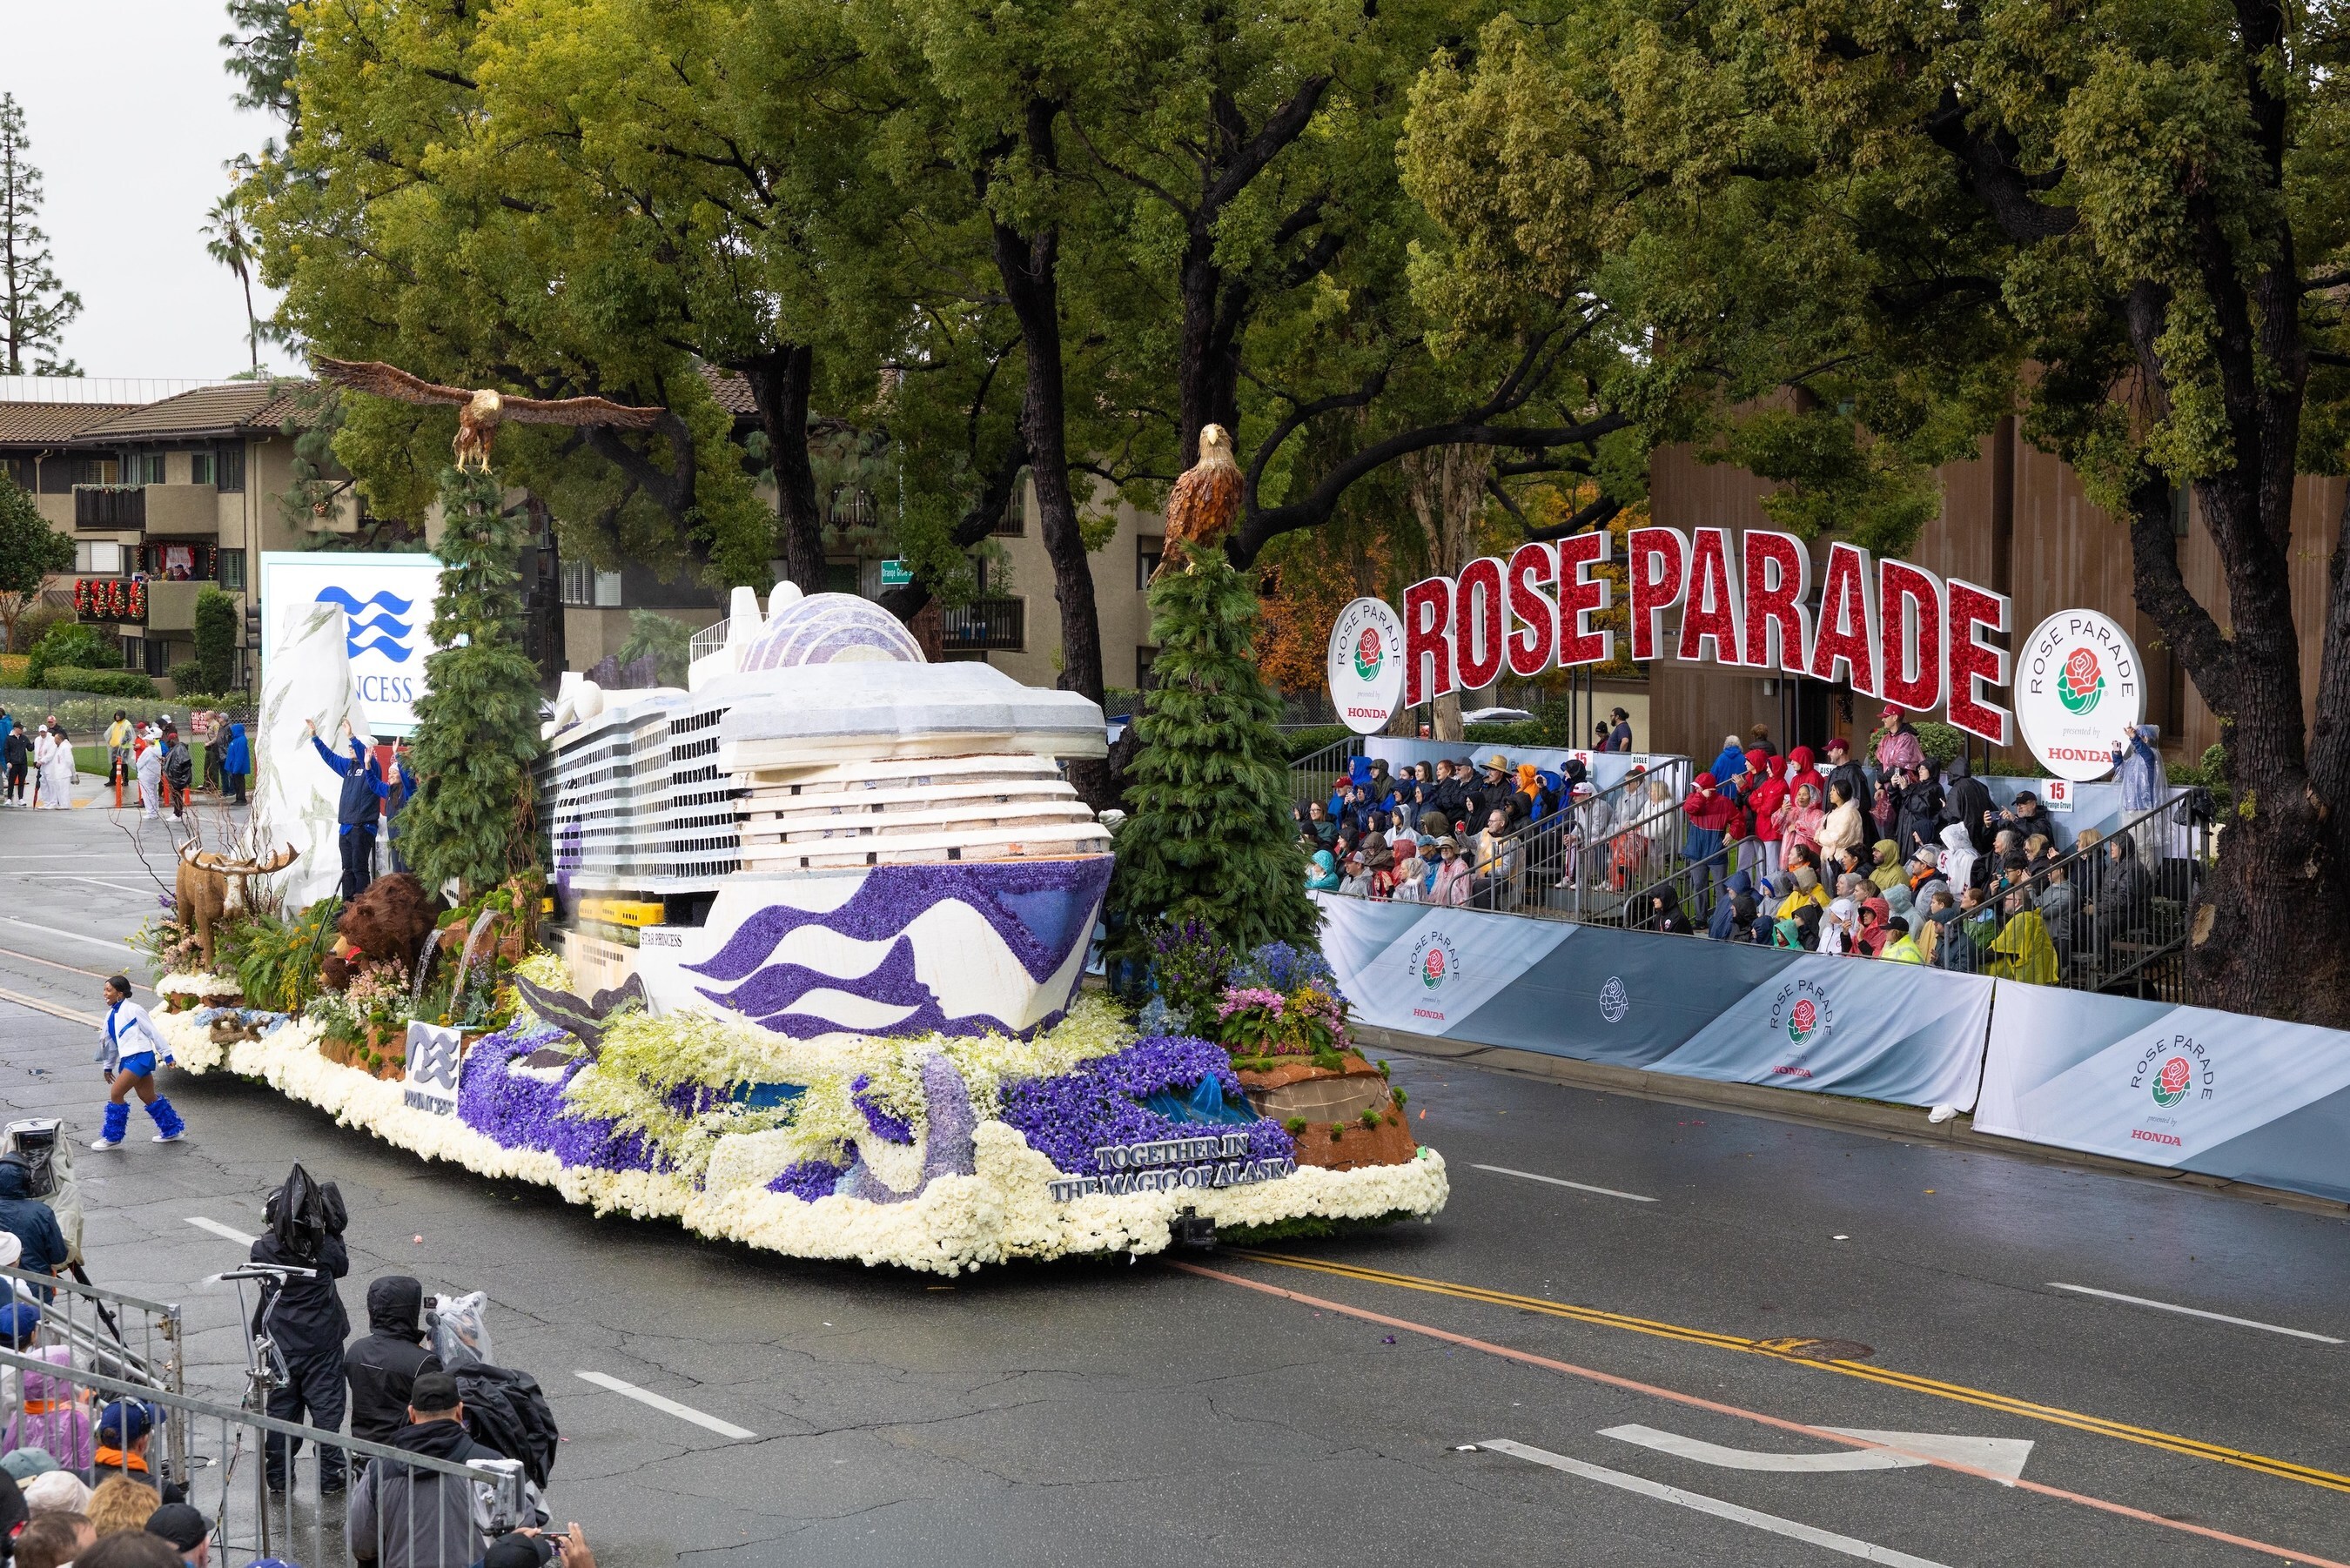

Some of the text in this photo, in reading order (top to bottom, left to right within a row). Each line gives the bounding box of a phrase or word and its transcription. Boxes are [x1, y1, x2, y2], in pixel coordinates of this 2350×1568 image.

[1338, 605, 1400, 667] ROSE PARADE
[1403, 526, 2013, 747] ROSE PARADE
[2031, 619, 2134, 698] ROSE PARADE
[356, 675, 413, 703] NCESS
[1347, 707, 1388, 720] HONDA
[2063, 727, 2101, 739] presented by
[2047, 747, 2114, 763] HONDA
[2050, 782, 2065, 801] 15
[2045, 801, 2059, 810] Orange
[641, 933, 682, 947] STAR PRINCESS
[1408, 931, 1460, 982] ROSE PARADE
[1413, 1008, 1445, 1021] HONDA
[1770, 980, 1833, 1035] ROSE PARADE
[1771, 1065, 1814, 1078] HONDA
[2131, 1035, 2214, 1100] ROSE PARADE
[404, 1089, 455, 1116] PRINCESS
[2146, 1115, 2178, 1128] presented by
[2131, 1129, 2182, 1147] HONDA
[1094, 1132, 1250, 1170] TOGETHER IN
[1047, 1157, 1299, 1203] THE MAGIC OF ALASKA
